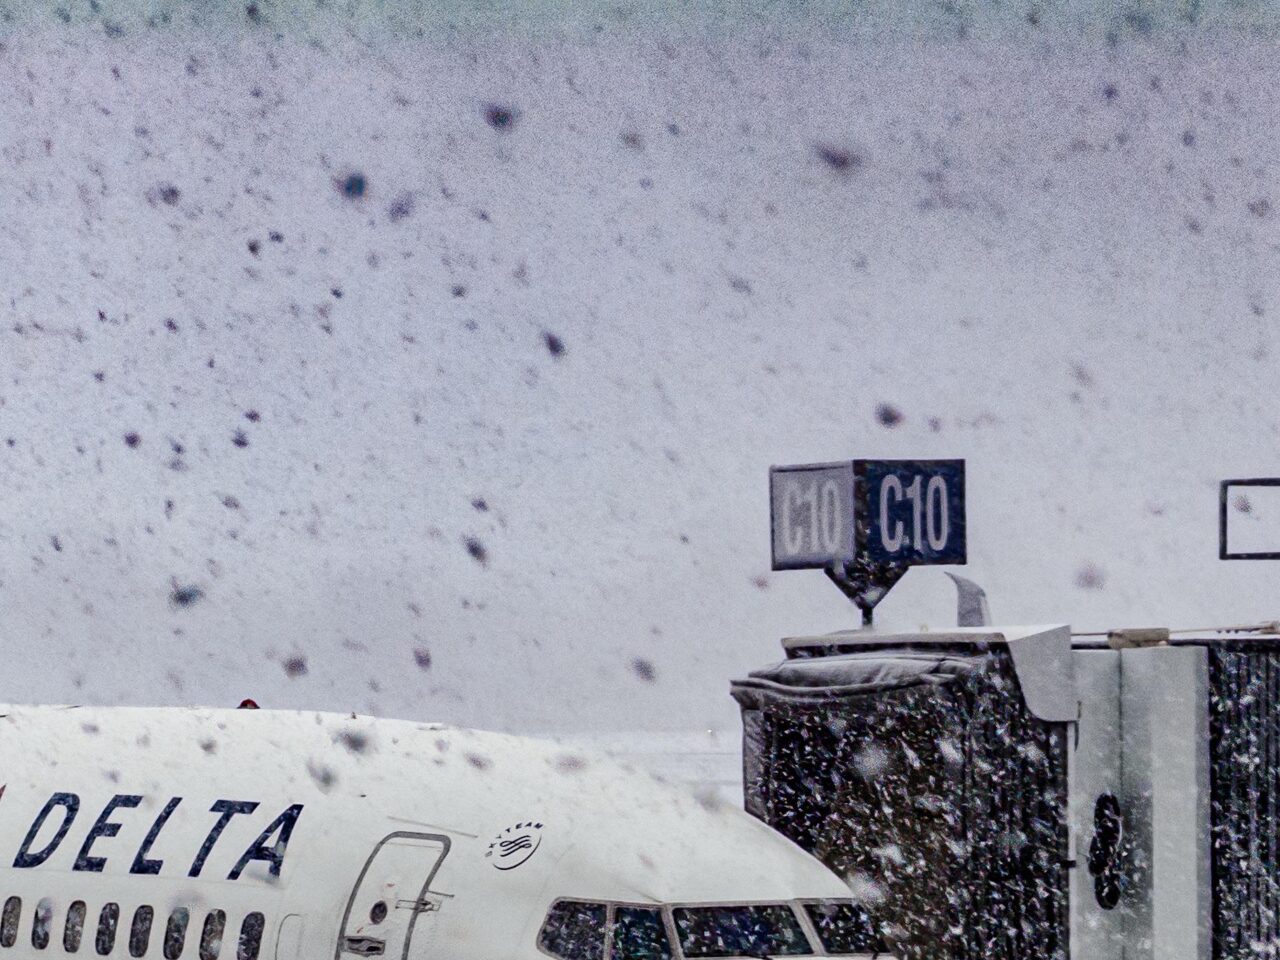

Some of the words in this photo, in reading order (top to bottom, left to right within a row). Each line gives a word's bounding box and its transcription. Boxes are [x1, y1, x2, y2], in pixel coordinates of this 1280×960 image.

[782, 479, 841, 555] C10
[880, 474, 949, 552] C10
[12, 792, 305, 880] DELTA
